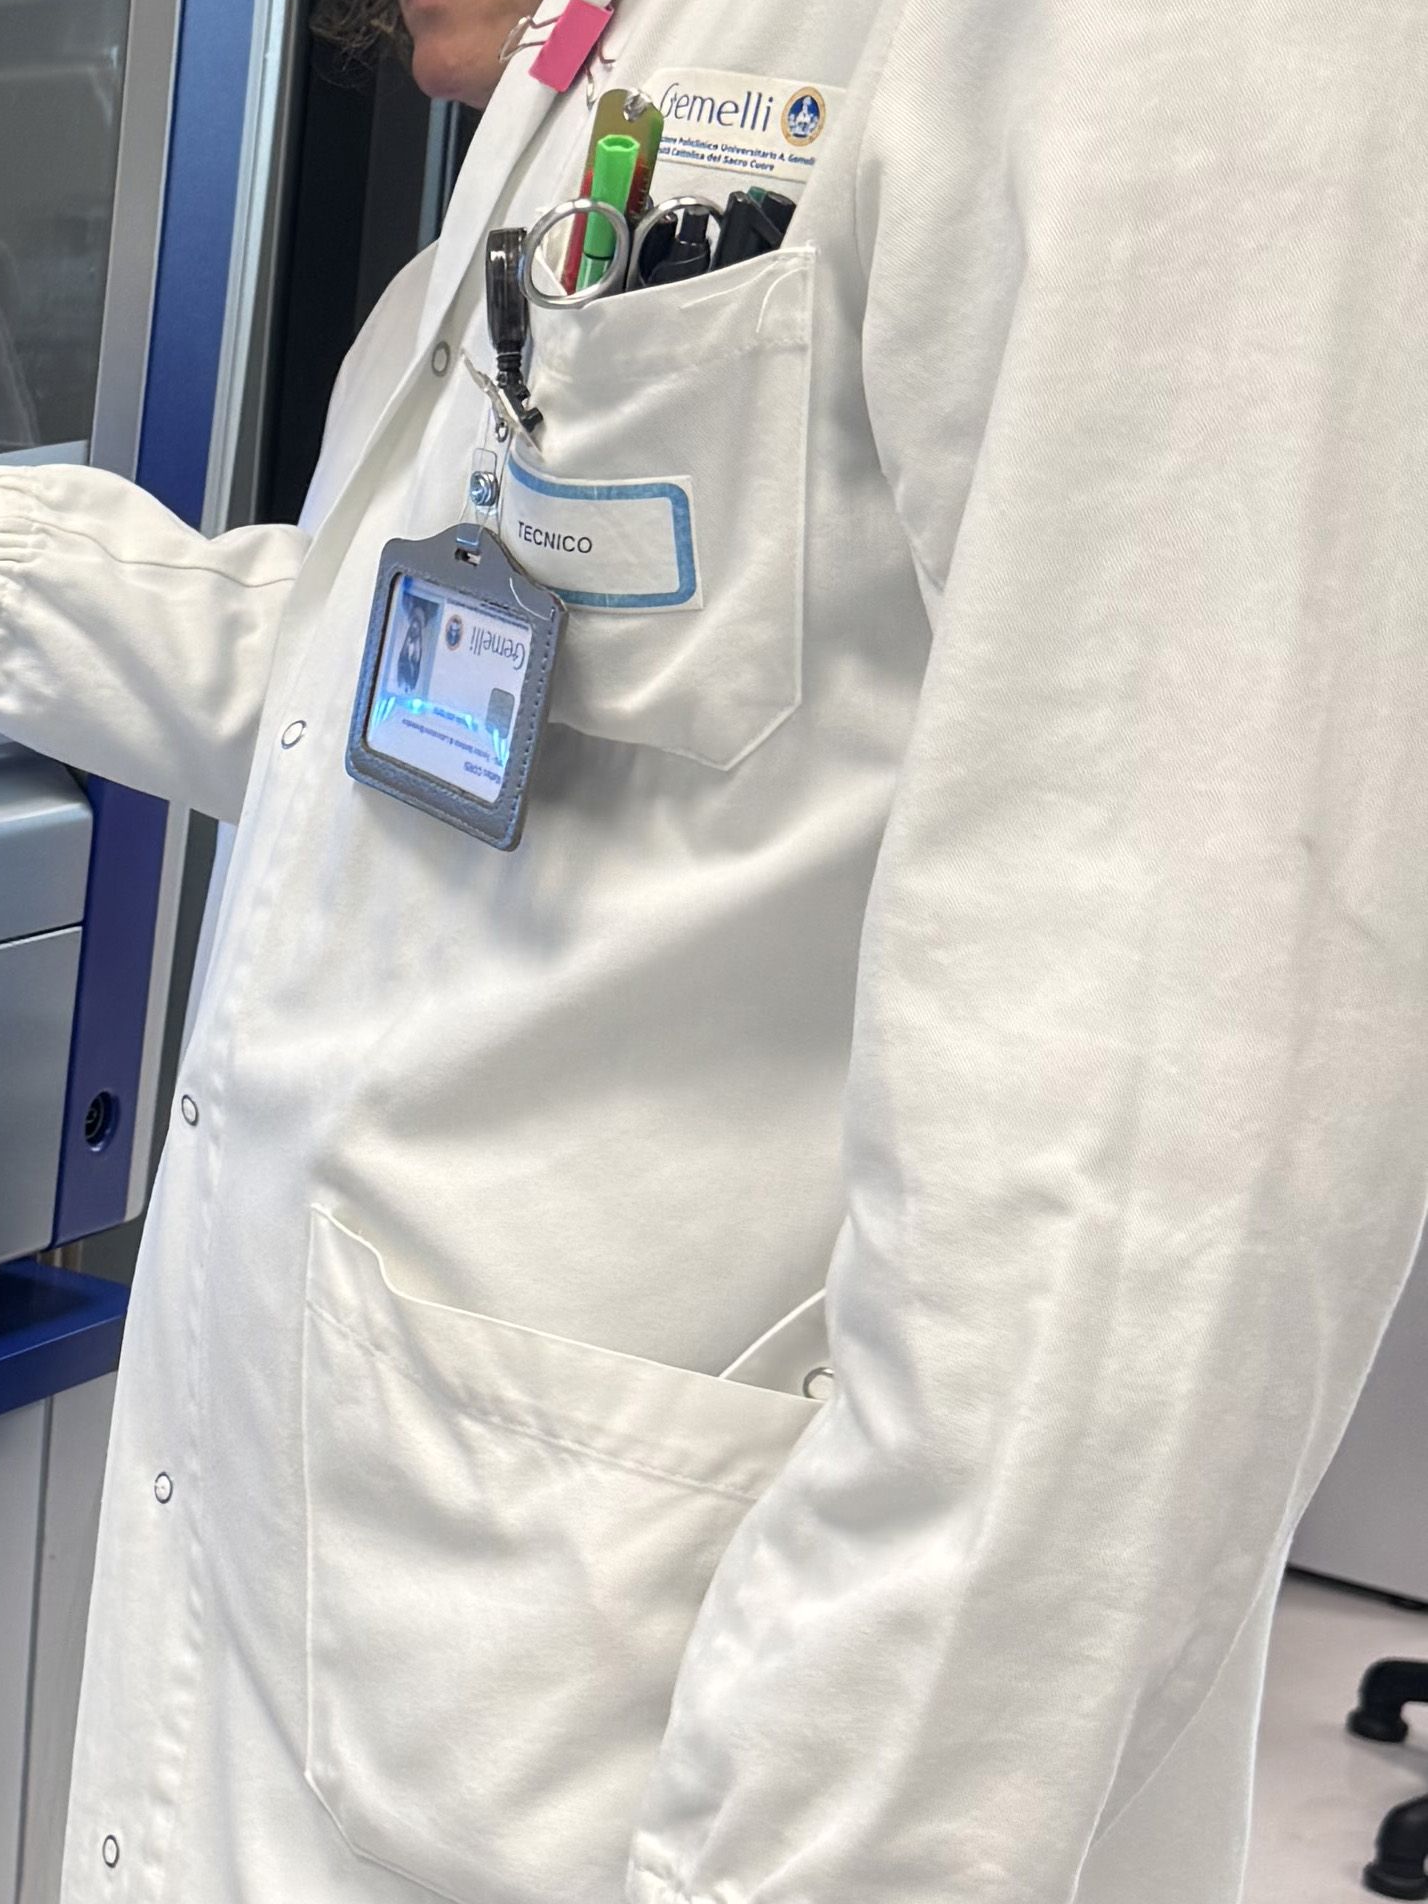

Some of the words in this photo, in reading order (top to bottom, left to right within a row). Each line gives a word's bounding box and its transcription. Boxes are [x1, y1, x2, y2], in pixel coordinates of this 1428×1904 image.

[660, 82, 774, 132] Gemelli
[723, 155, 748, 167] Sacro
[750, 159, 775, 171] Cuore
[518, 520, 593, 554] TECNICO
